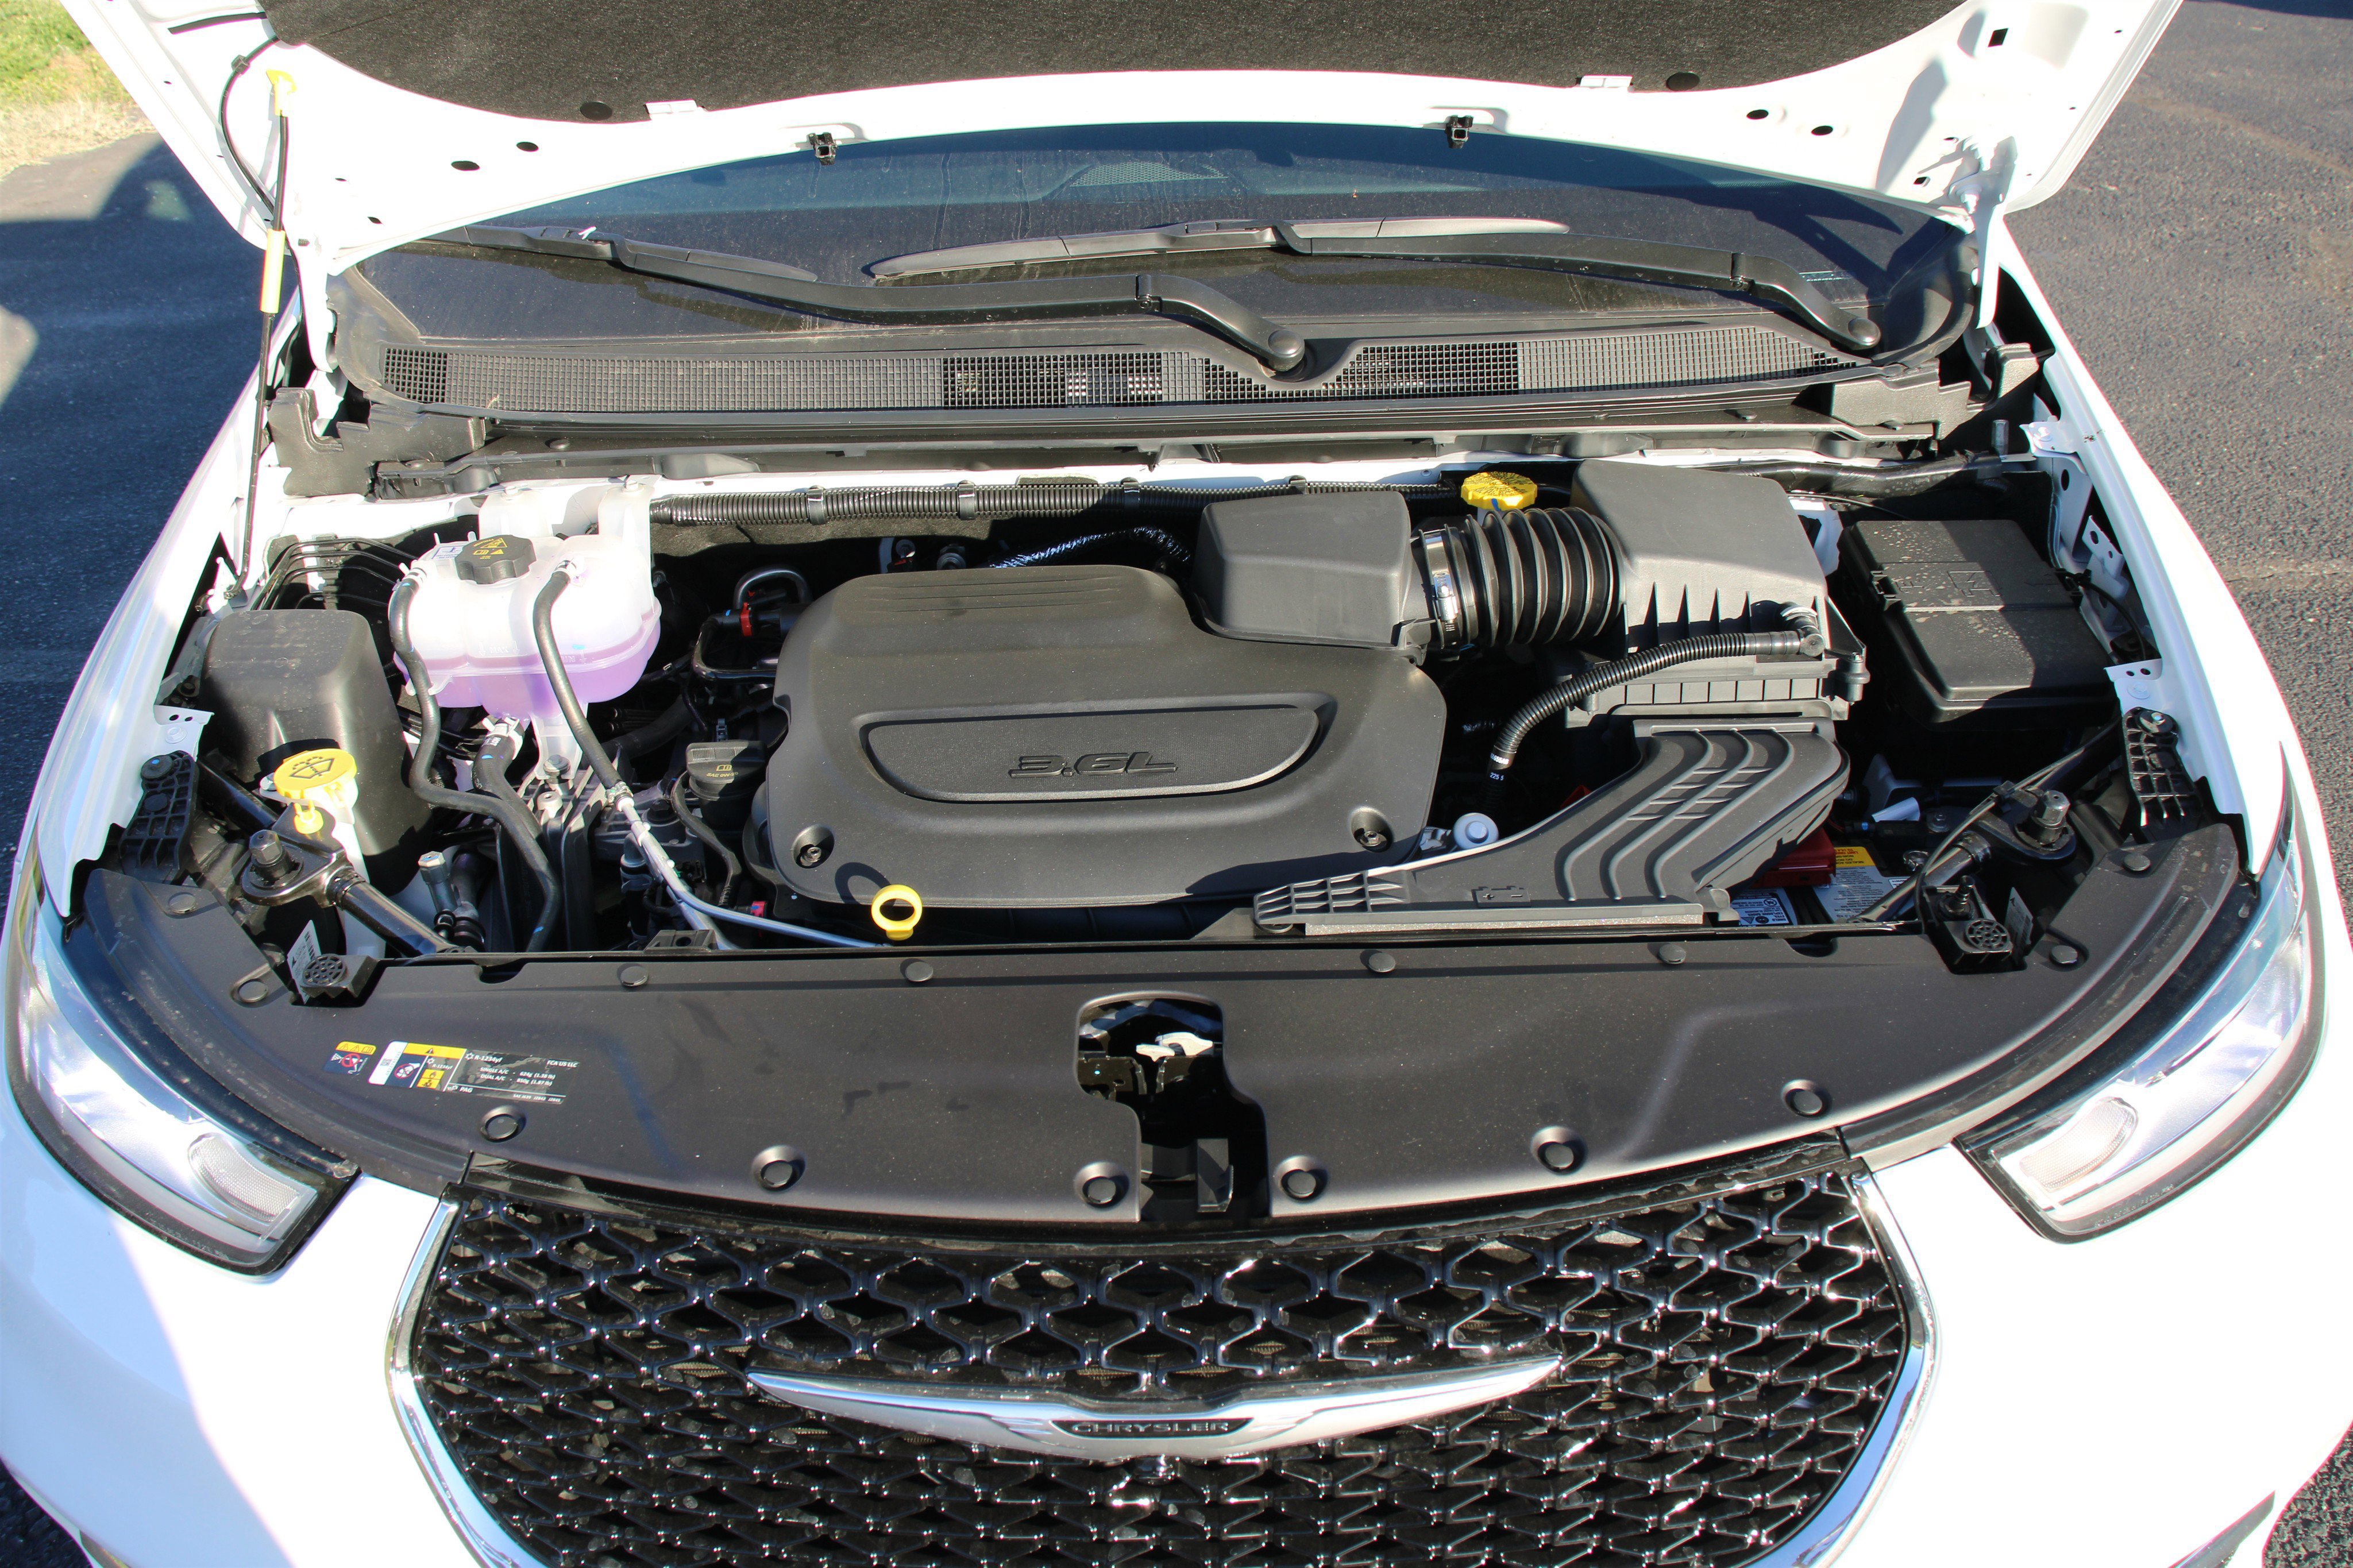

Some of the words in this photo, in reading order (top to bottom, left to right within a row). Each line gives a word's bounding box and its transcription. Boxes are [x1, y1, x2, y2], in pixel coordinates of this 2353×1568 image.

[1008, 751, 1178, 777] 3.6L
[1490, 772, 1499, 780] 225
[474, 1055, 503, 1064] R-1234yf
[1072, 1422, 1229, 1434] CHRYSLER
